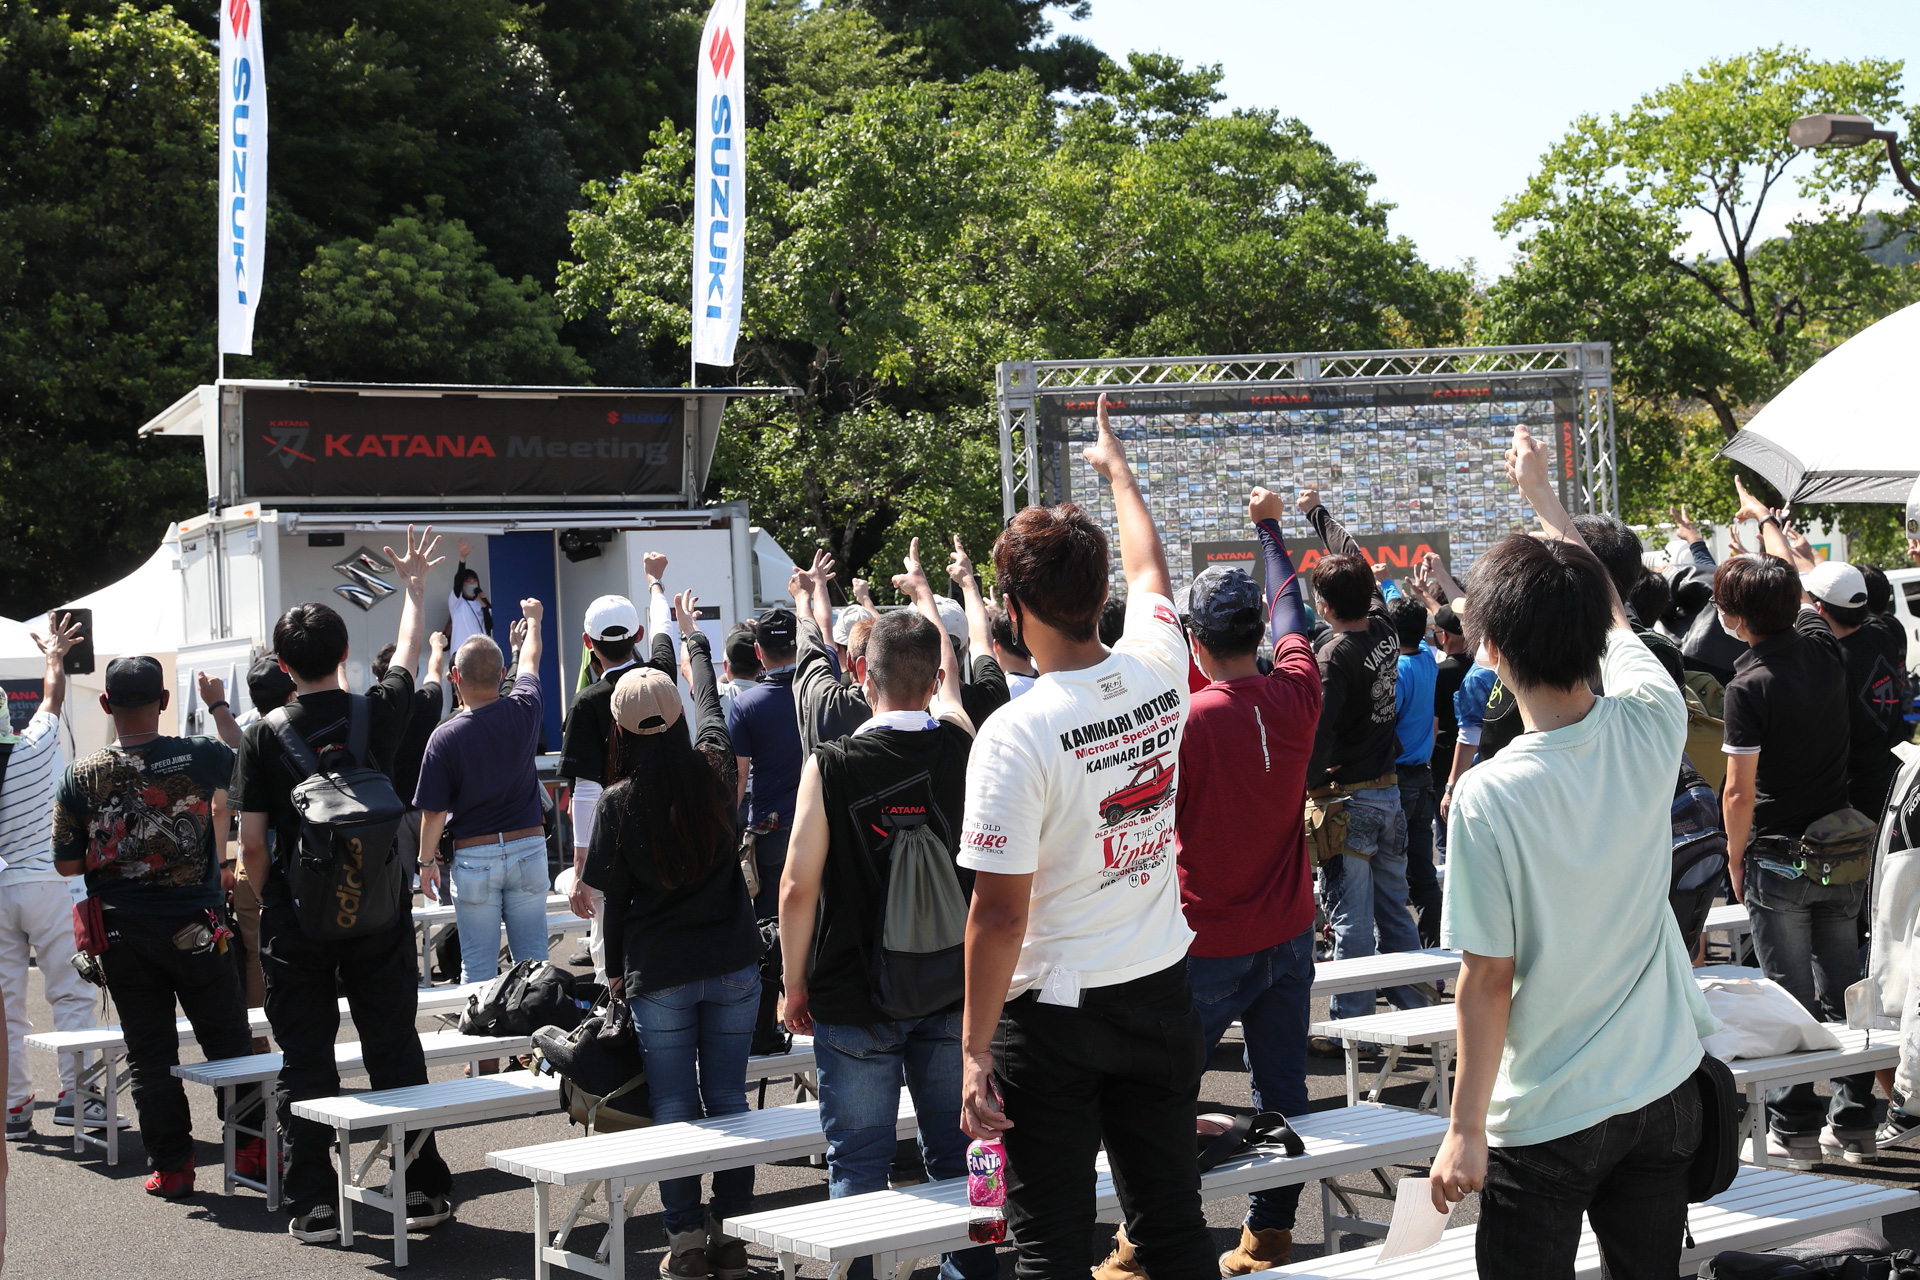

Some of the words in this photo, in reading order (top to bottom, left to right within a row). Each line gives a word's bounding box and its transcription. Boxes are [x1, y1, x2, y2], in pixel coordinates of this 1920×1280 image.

[232, 57, 251, 305] SUZUKI
[706, 94, 732, 319] SUZUKI
[1250, 394, 1311, 405] KATANA
[1432, 387, 1491, 398] KATANA
[1065, 400, 1127, 411] KATNA
[1130, 399, 1191, 410] Meeting
[621, 413, 673, 424] SUZUKI
[324, 434, 497, 458] KATANA
[506, 435, 669, 466] Meeting
[1562, 421, 1575, 479] KATANA
[1206, 551, 1256, 561] KATANA
[1060, 713, 1133, 752] KAMINARI
[1132, 688, 1180, 726] MOTORS
[1075, 739, 1119, 759] Microcar
[1122, 720, 1160, 744] Special
[1160, 711, 1180, 726] Shop
[1086, 746, 1139, 774] KAMINARI
[1142, 723, 1178, 757] BOY
[150, 758, 171, 771] SPEED
[171, 753, 193, 765] JUNKIE
[982, 823, 1001, 832] OLD
[1094, 830, 1109, 839] OLD
[1110, 819, 1138, 834] SCHOOL
[1134, 827, 1154, 842] THE
[336, 837, 363, 928] adidas
[966, 1153, 1001, 1171] FANTA
